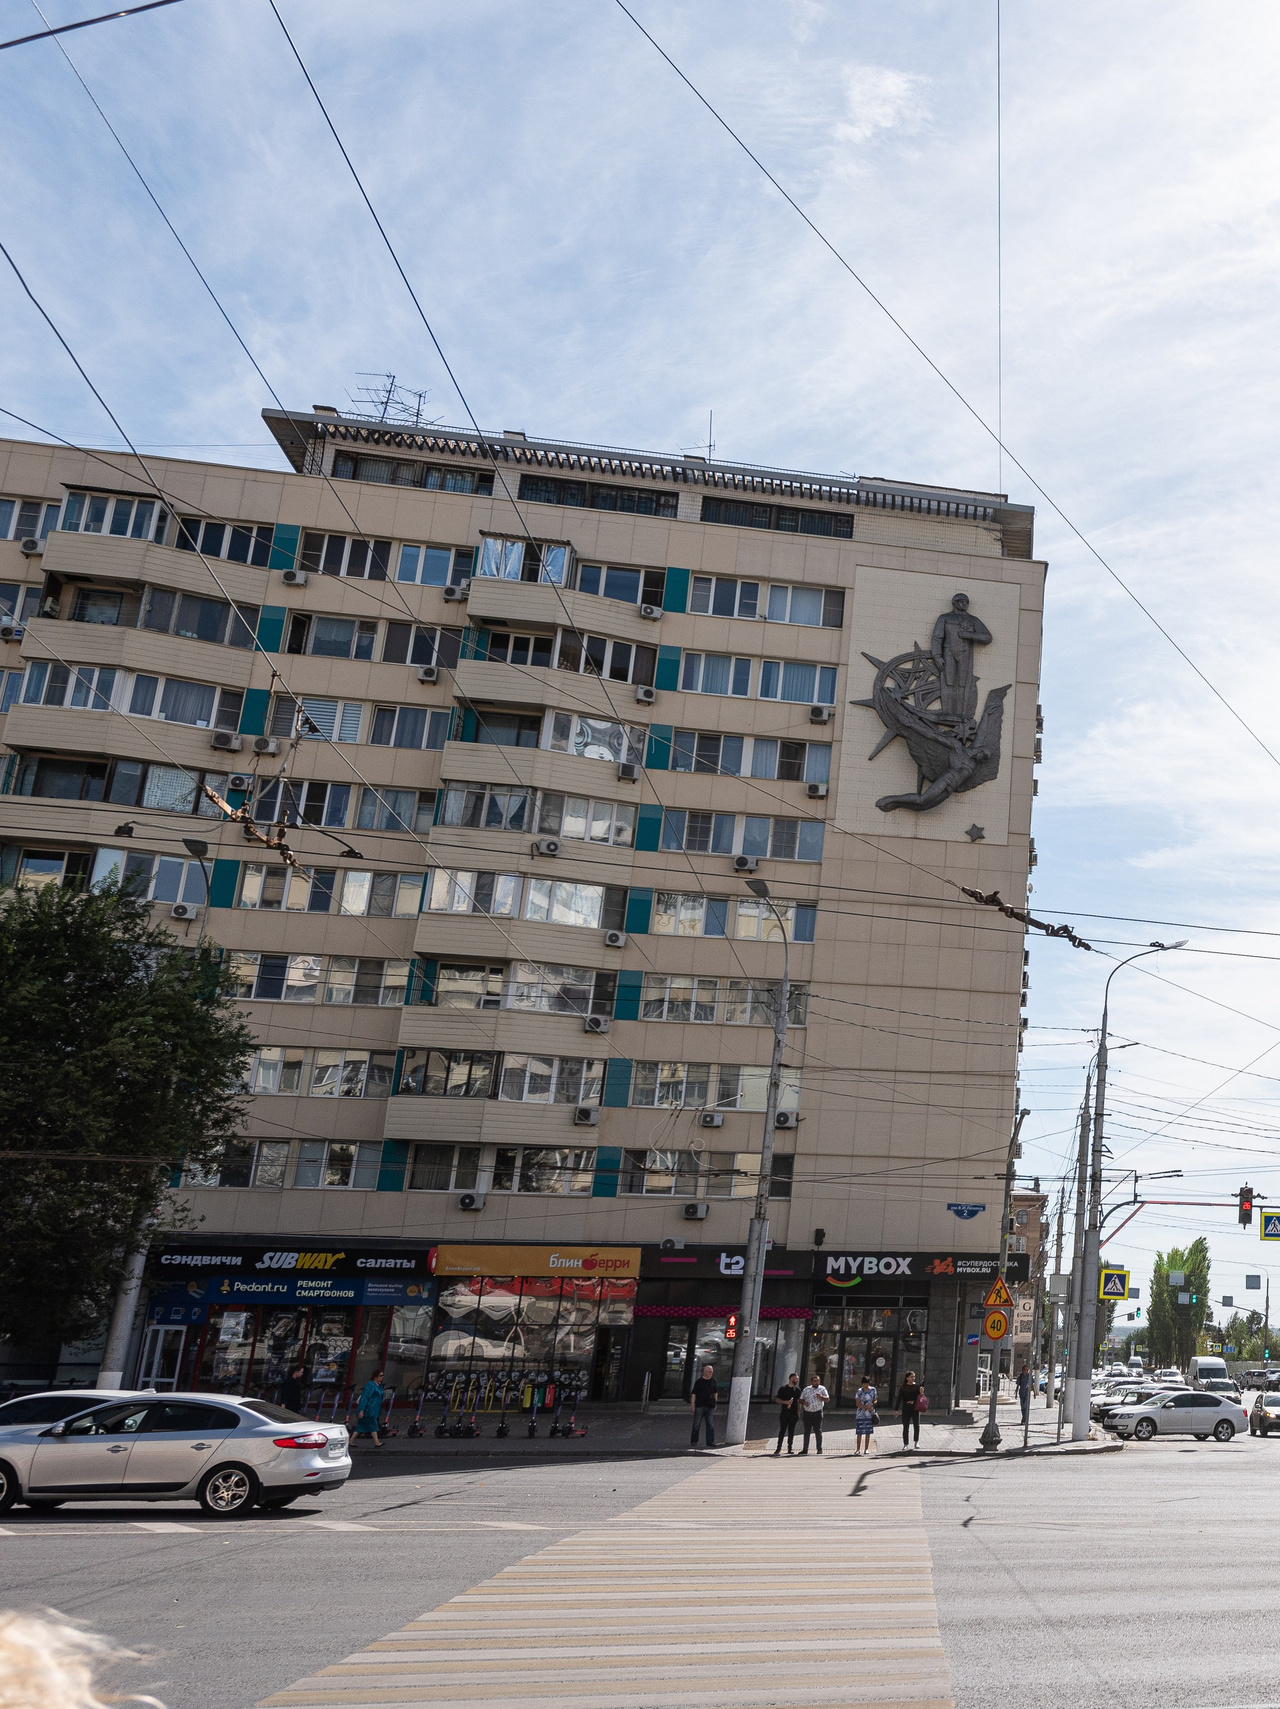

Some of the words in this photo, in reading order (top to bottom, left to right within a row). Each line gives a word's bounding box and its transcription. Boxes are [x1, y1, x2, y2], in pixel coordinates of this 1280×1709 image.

[161, 1254, 243, 1267] сэндвичи
[255, 1251, 346, 1270] SUBWAY
[356, 1258, 416, 1269] салаты
[719, 1252, 745, 1275] t2
[826, 1256, 912, 1275] MYBOX
[233, 1281, 288, 1293] Pedant.ru
[297, 1280, 333, 1288] РЕМОНТ
[296, 1290, 355, 1298] СМАРТФОНОВ
[990, 1318, 1002, 1332] 40
[726, 1329, 736, 1338] 26
